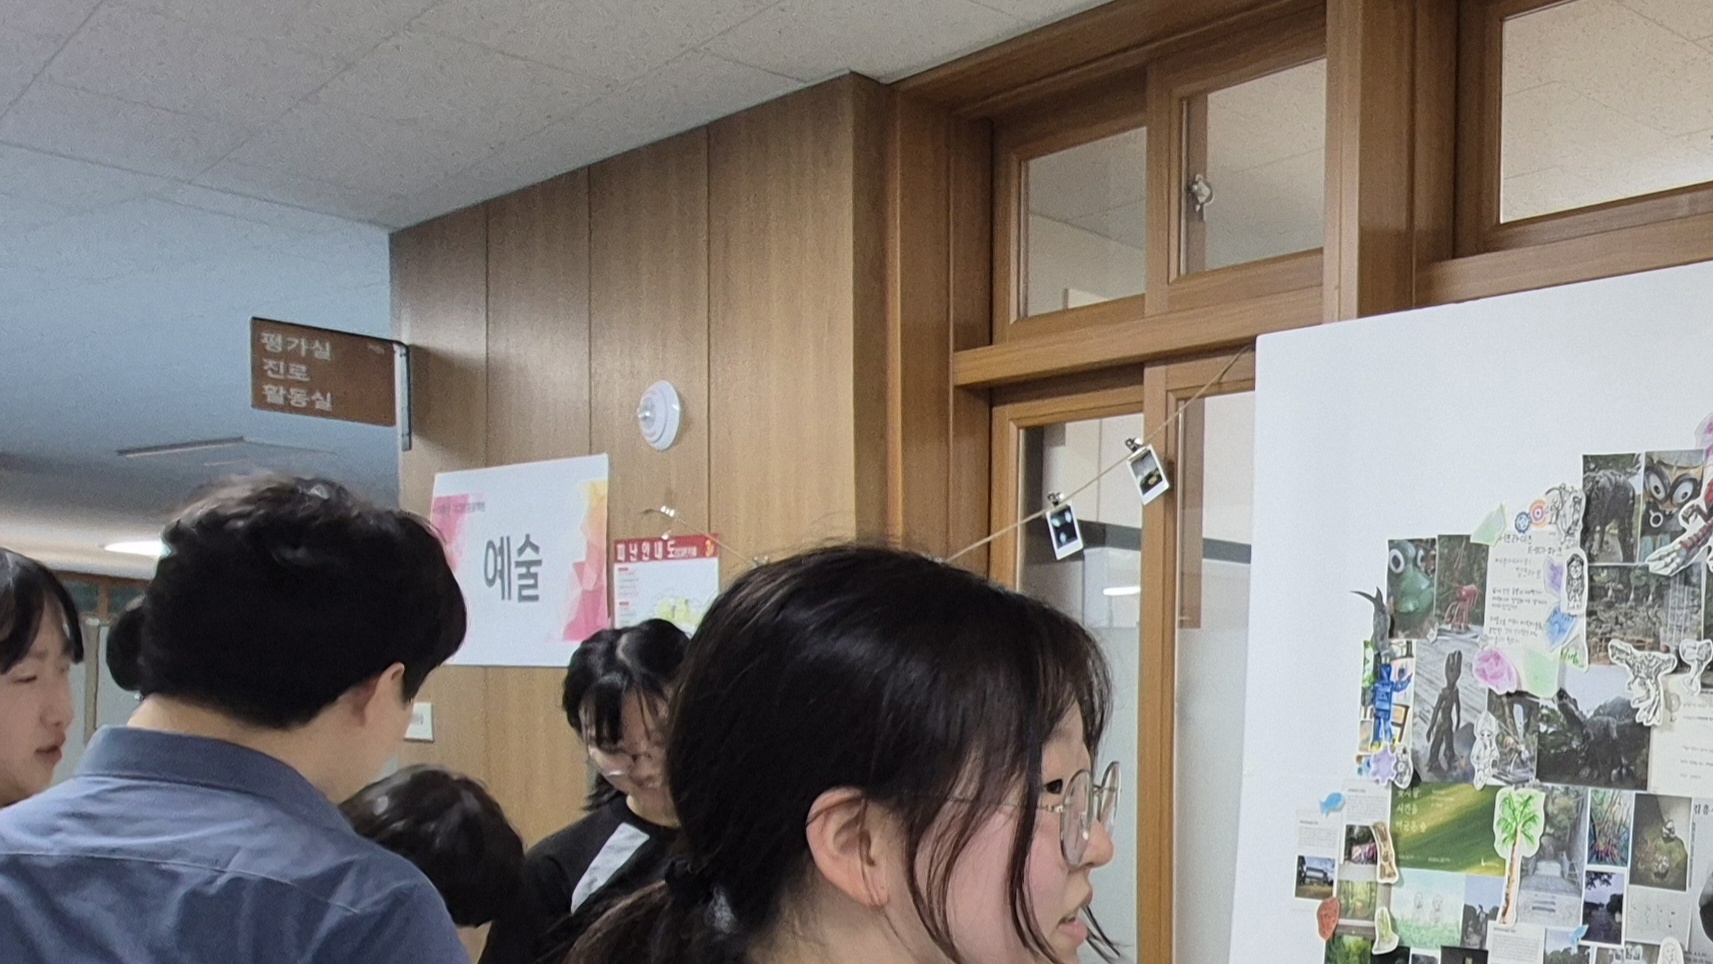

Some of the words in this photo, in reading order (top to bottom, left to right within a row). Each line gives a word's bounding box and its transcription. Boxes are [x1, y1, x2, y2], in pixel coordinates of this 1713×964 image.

[261, 331, 331, 361] 평가실
[262, 358, 310, 381] 진로
[262, 384, 332, 411] 활동실
[484, 533, 542, 602] 예술
